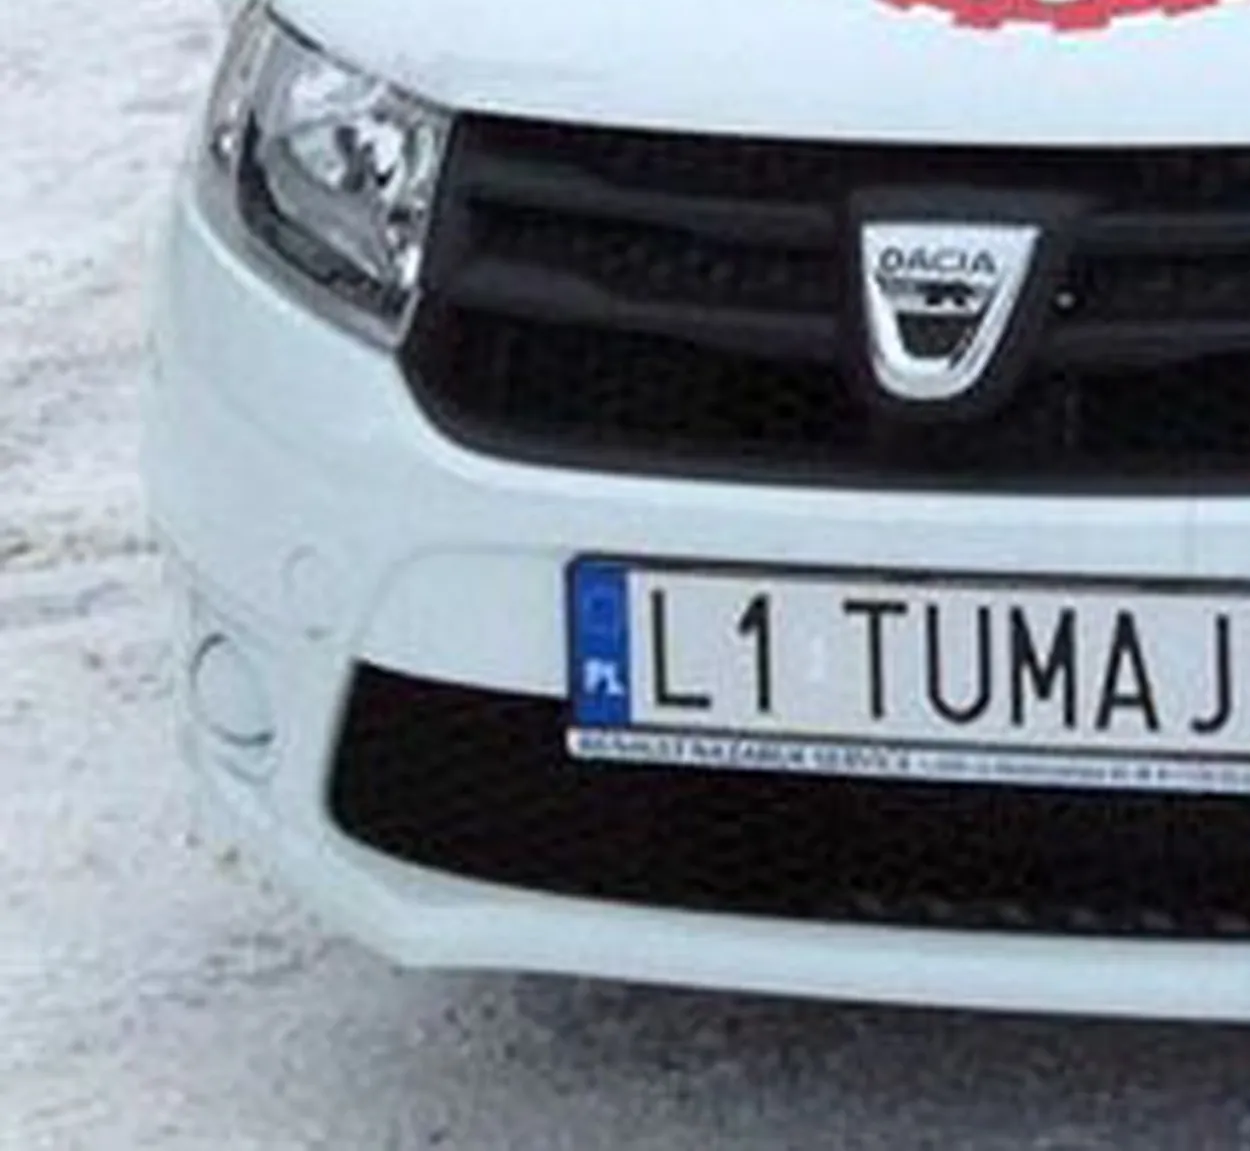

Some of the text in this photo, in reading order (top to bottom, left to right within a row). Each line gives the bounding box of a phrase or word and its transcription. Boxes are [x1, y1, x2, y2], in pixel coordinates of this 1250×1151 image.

[879, 246, 996, 273] DACIA
[584, 659, 624, 695] PL
[652, 589, 1231, 734] L1 TUMAJ
